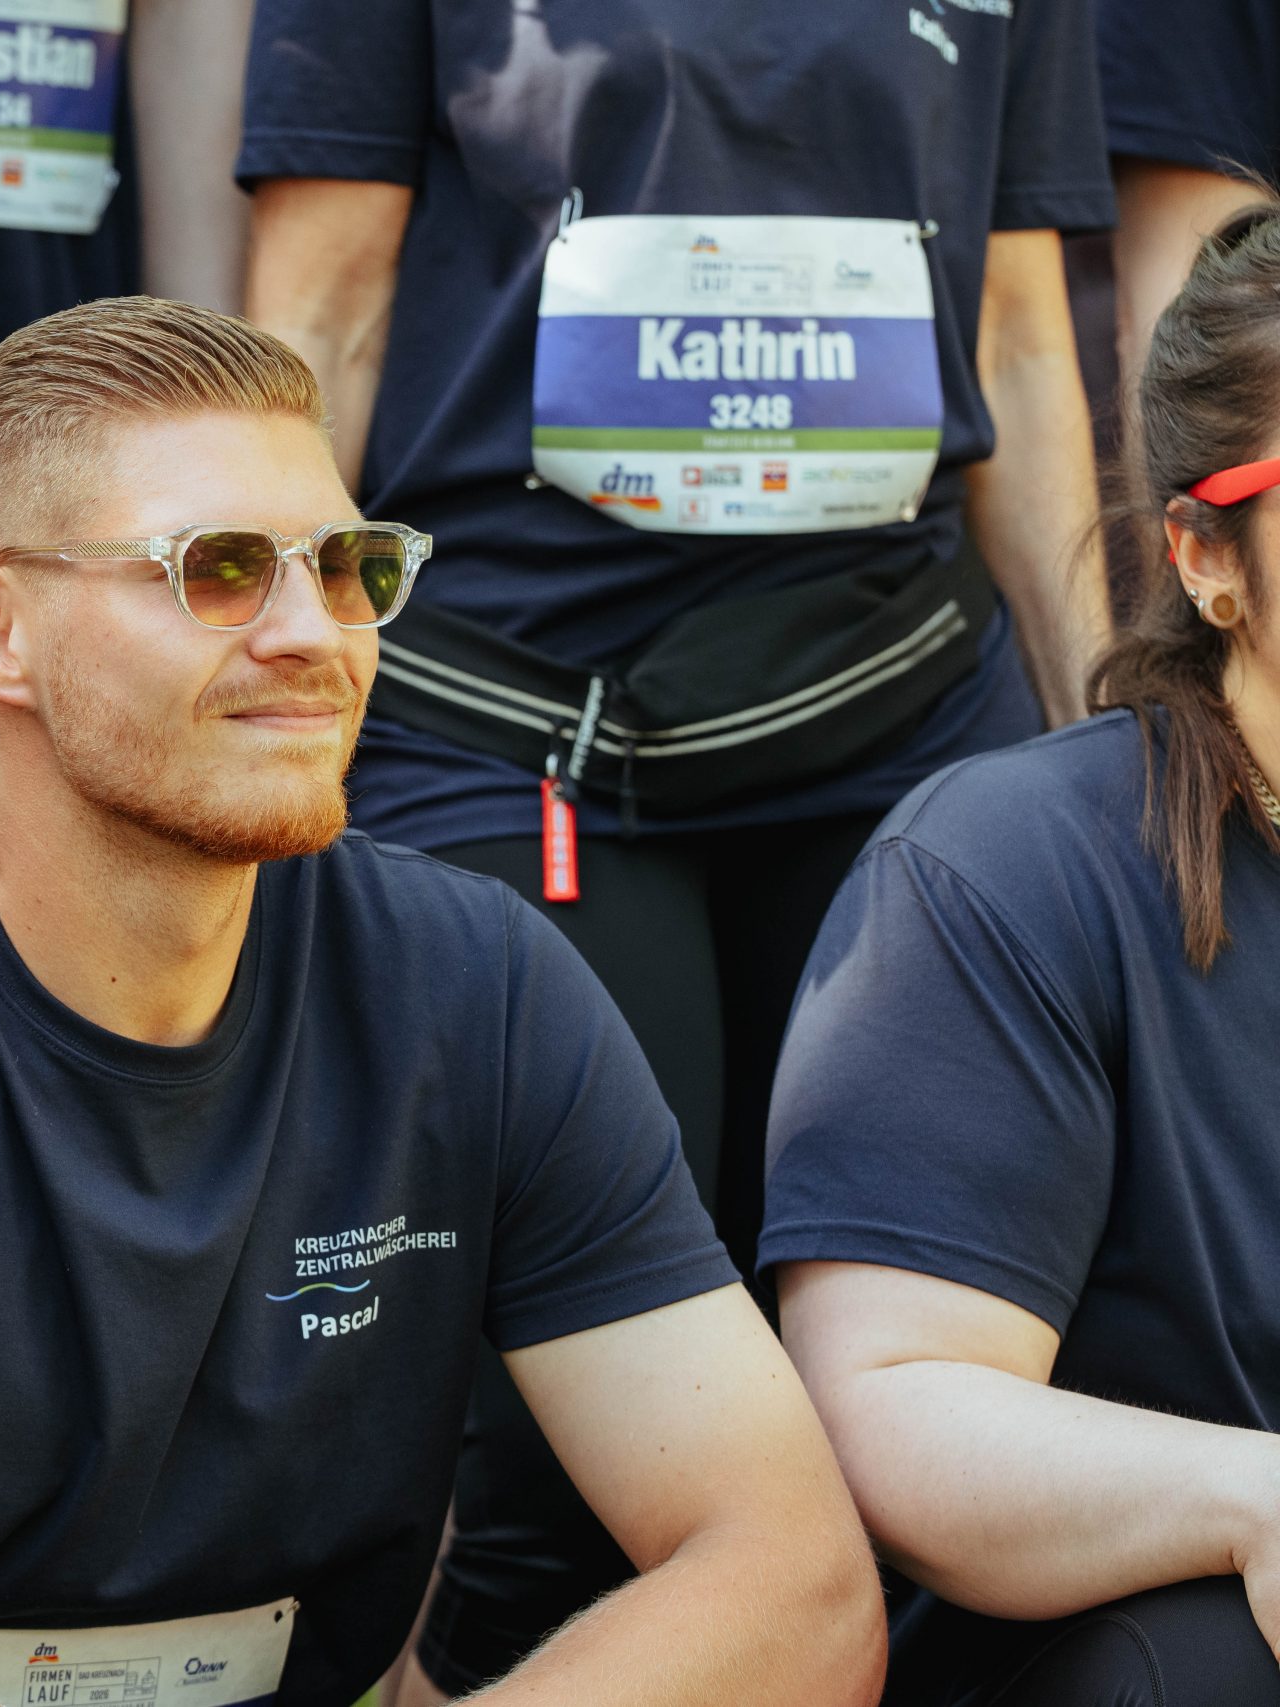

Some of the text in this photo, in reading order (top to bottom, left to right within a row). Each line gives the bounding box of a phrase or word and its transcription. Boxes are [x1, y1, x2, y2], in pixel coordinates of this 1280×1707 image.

[637, 318, 857, 381] Kathrin
[709, 394, 794, 429] 3248
[600, 463, 656, 496] dm
[294, 1215, 407, 1255] KREUZNACHER
[295, 1231, 457, 1277] ZENTRALWÄSCHEREI
[300, 1295, 380, 1340] Pascal
[34, 1642, 58, 1656] dm
[27, 1684, 71, 1703] LAUF
[29, 1669, 73, 1683] FIRMEN
